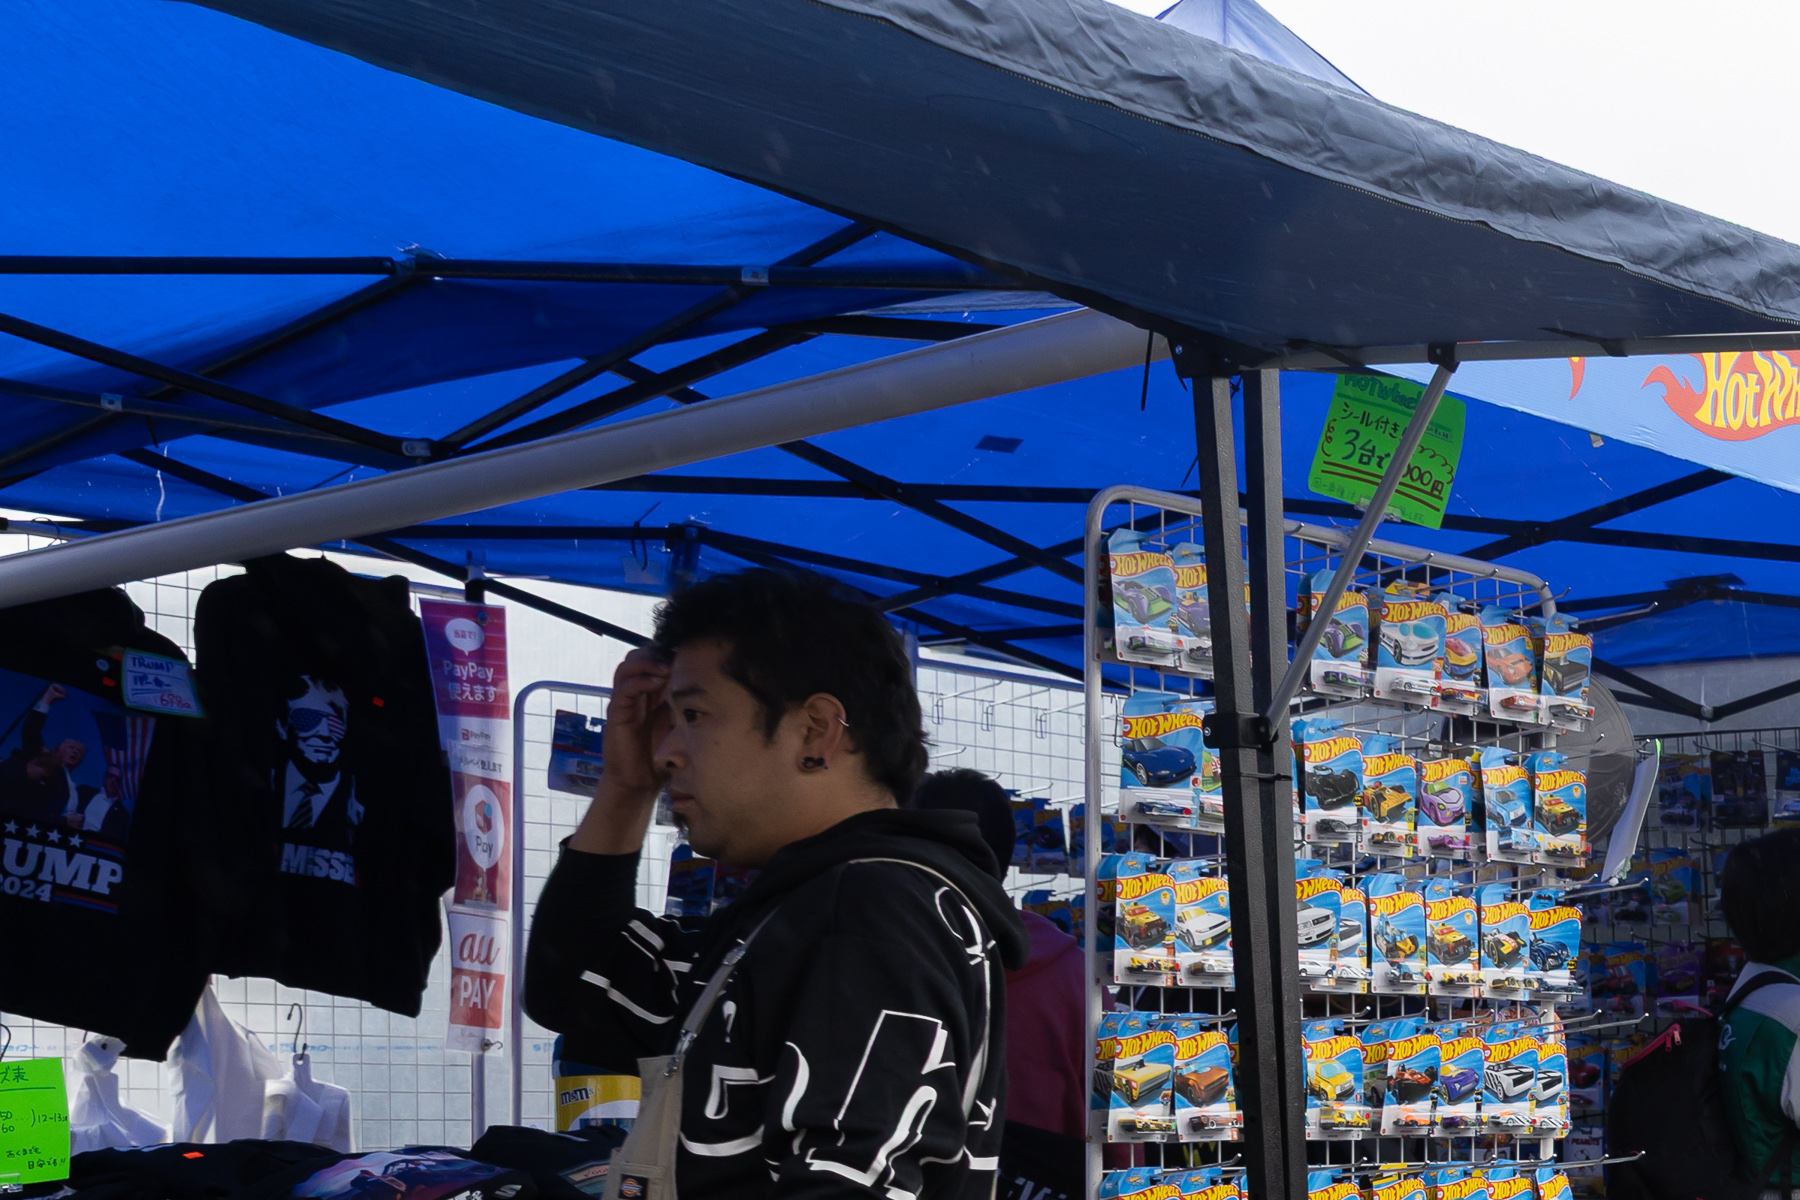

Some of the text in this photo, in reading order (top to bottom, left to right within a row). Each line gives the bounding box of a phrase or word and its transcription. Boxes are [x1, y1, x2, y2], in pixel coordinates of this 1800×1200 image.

[443, 659, 495, 683] PayPay
[449, 683, 497, 703] 使えます
[475, 835, 494, 858] Pay
[458, 932, 501, 966] au
[458, 974, 496, 1010] PAY
[1571, 1138, 1600, 1146] PEANUTS
